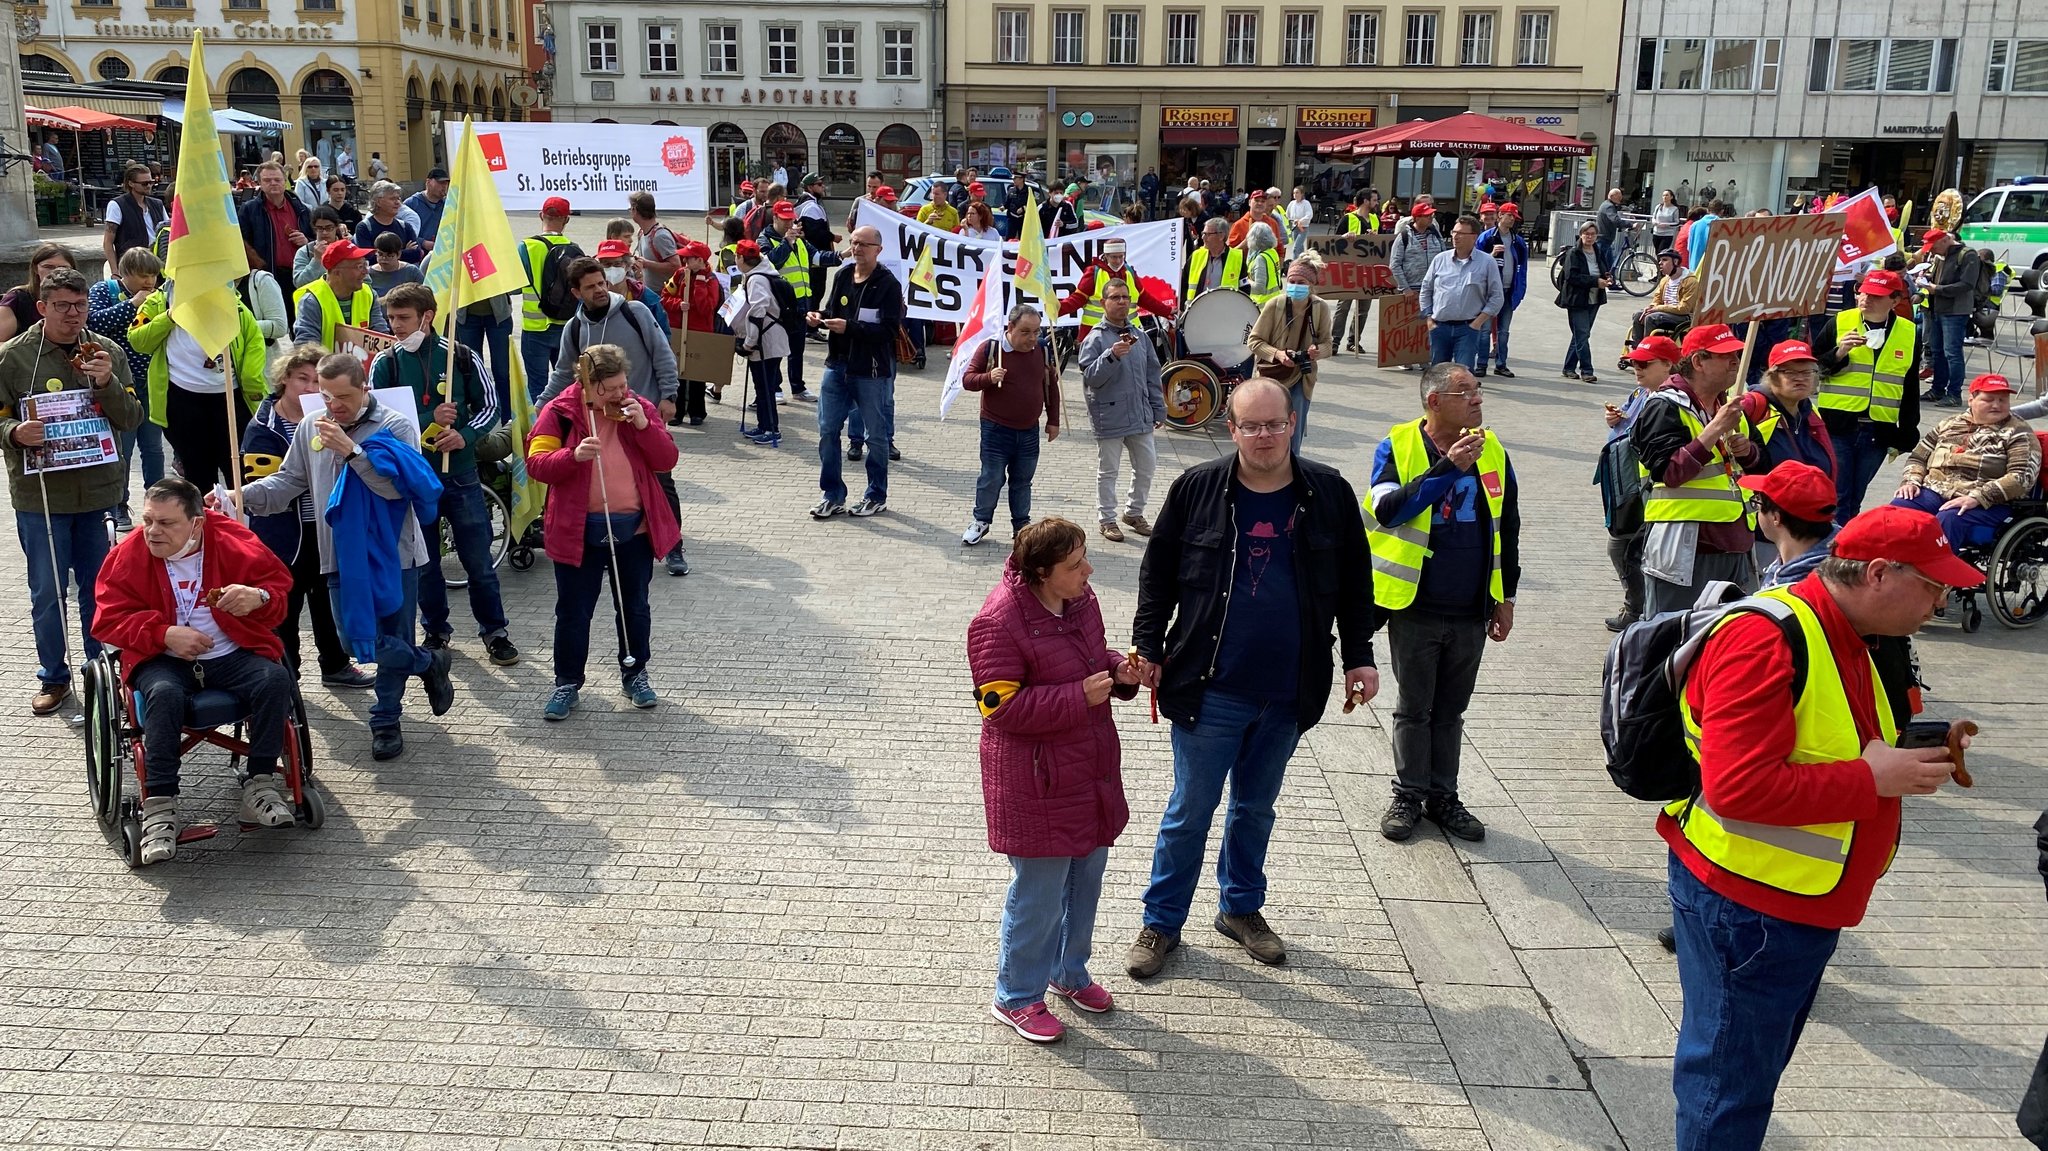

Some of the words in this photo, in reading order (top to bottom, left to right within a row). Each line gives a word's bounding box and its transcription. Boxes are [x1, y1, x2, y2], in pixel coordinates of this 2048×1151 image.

[95, 23, 221, 38] BERUFSKLEIDNG
[649, 86, 724, 103] MARKT
[741, 88, 857, 105] APOTHEKE
[1169, 109, 1230, 121] Rösner
[1306, 109, 1367, 121] Rösner
[1535, 116, 1562, 124] ecco
[1883, 125, 1946, 134] MARKTPASSAG
[1409, 140, 1445, 149] Rösner
[1448, 142, 1492, 150] BACKSTUBE
[1543, 145, 1586, 154] BACKSTUBE
[542, 147, 631, 171] Betriebsgruppe
[1686, 151, 1735, 162] HABAKUK
[517, 173, 535, 191] St.
[539, 172, 608, 191] Josefs-Stift
[614, 174, 658, 191] Eisingen
[1169, 222, 1177, 262] verdi.de
[1999, 232, 2028, 242] POLIZEI
[898, 222, 985, 282] WIR
[1318, 261, 1397, 289] MEHR
[1384, 302, 1420, 326] PFLE
[362, 334, 380, 352] FÜR
